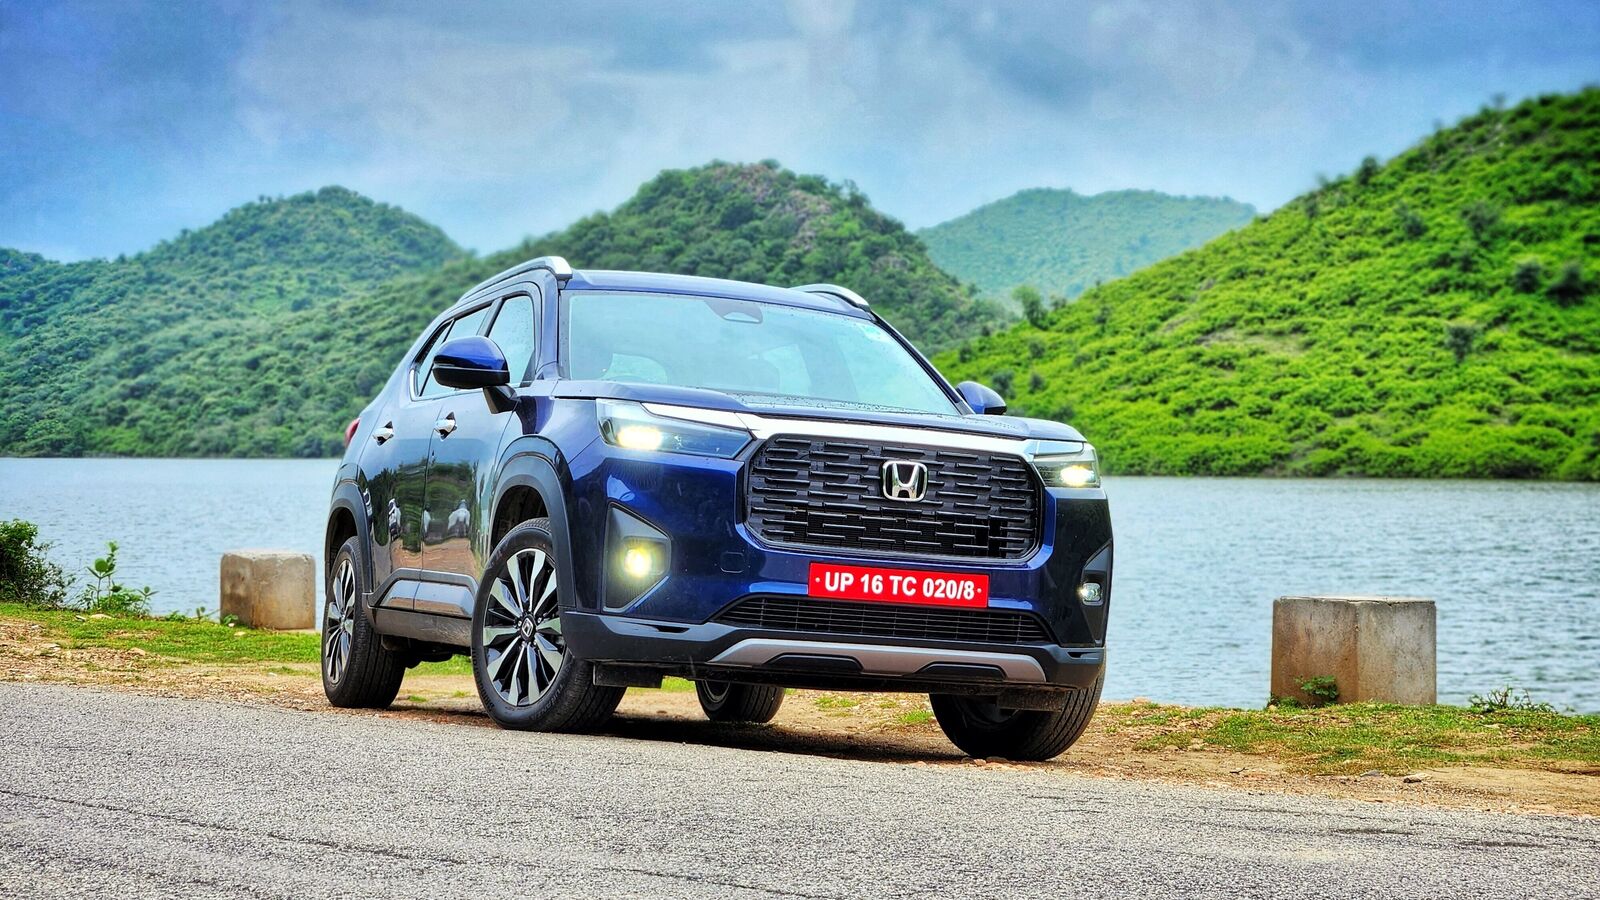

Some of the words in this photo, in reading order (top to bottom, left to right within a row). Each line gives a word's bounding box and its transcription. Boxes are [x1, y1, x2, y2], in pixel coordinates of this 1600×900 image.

[825, 571, 854, 592] UP
[860, 573, 883, 594] 16
[889, 575, 917, 597] TC
[922, 577, 975, 600] 020/8
